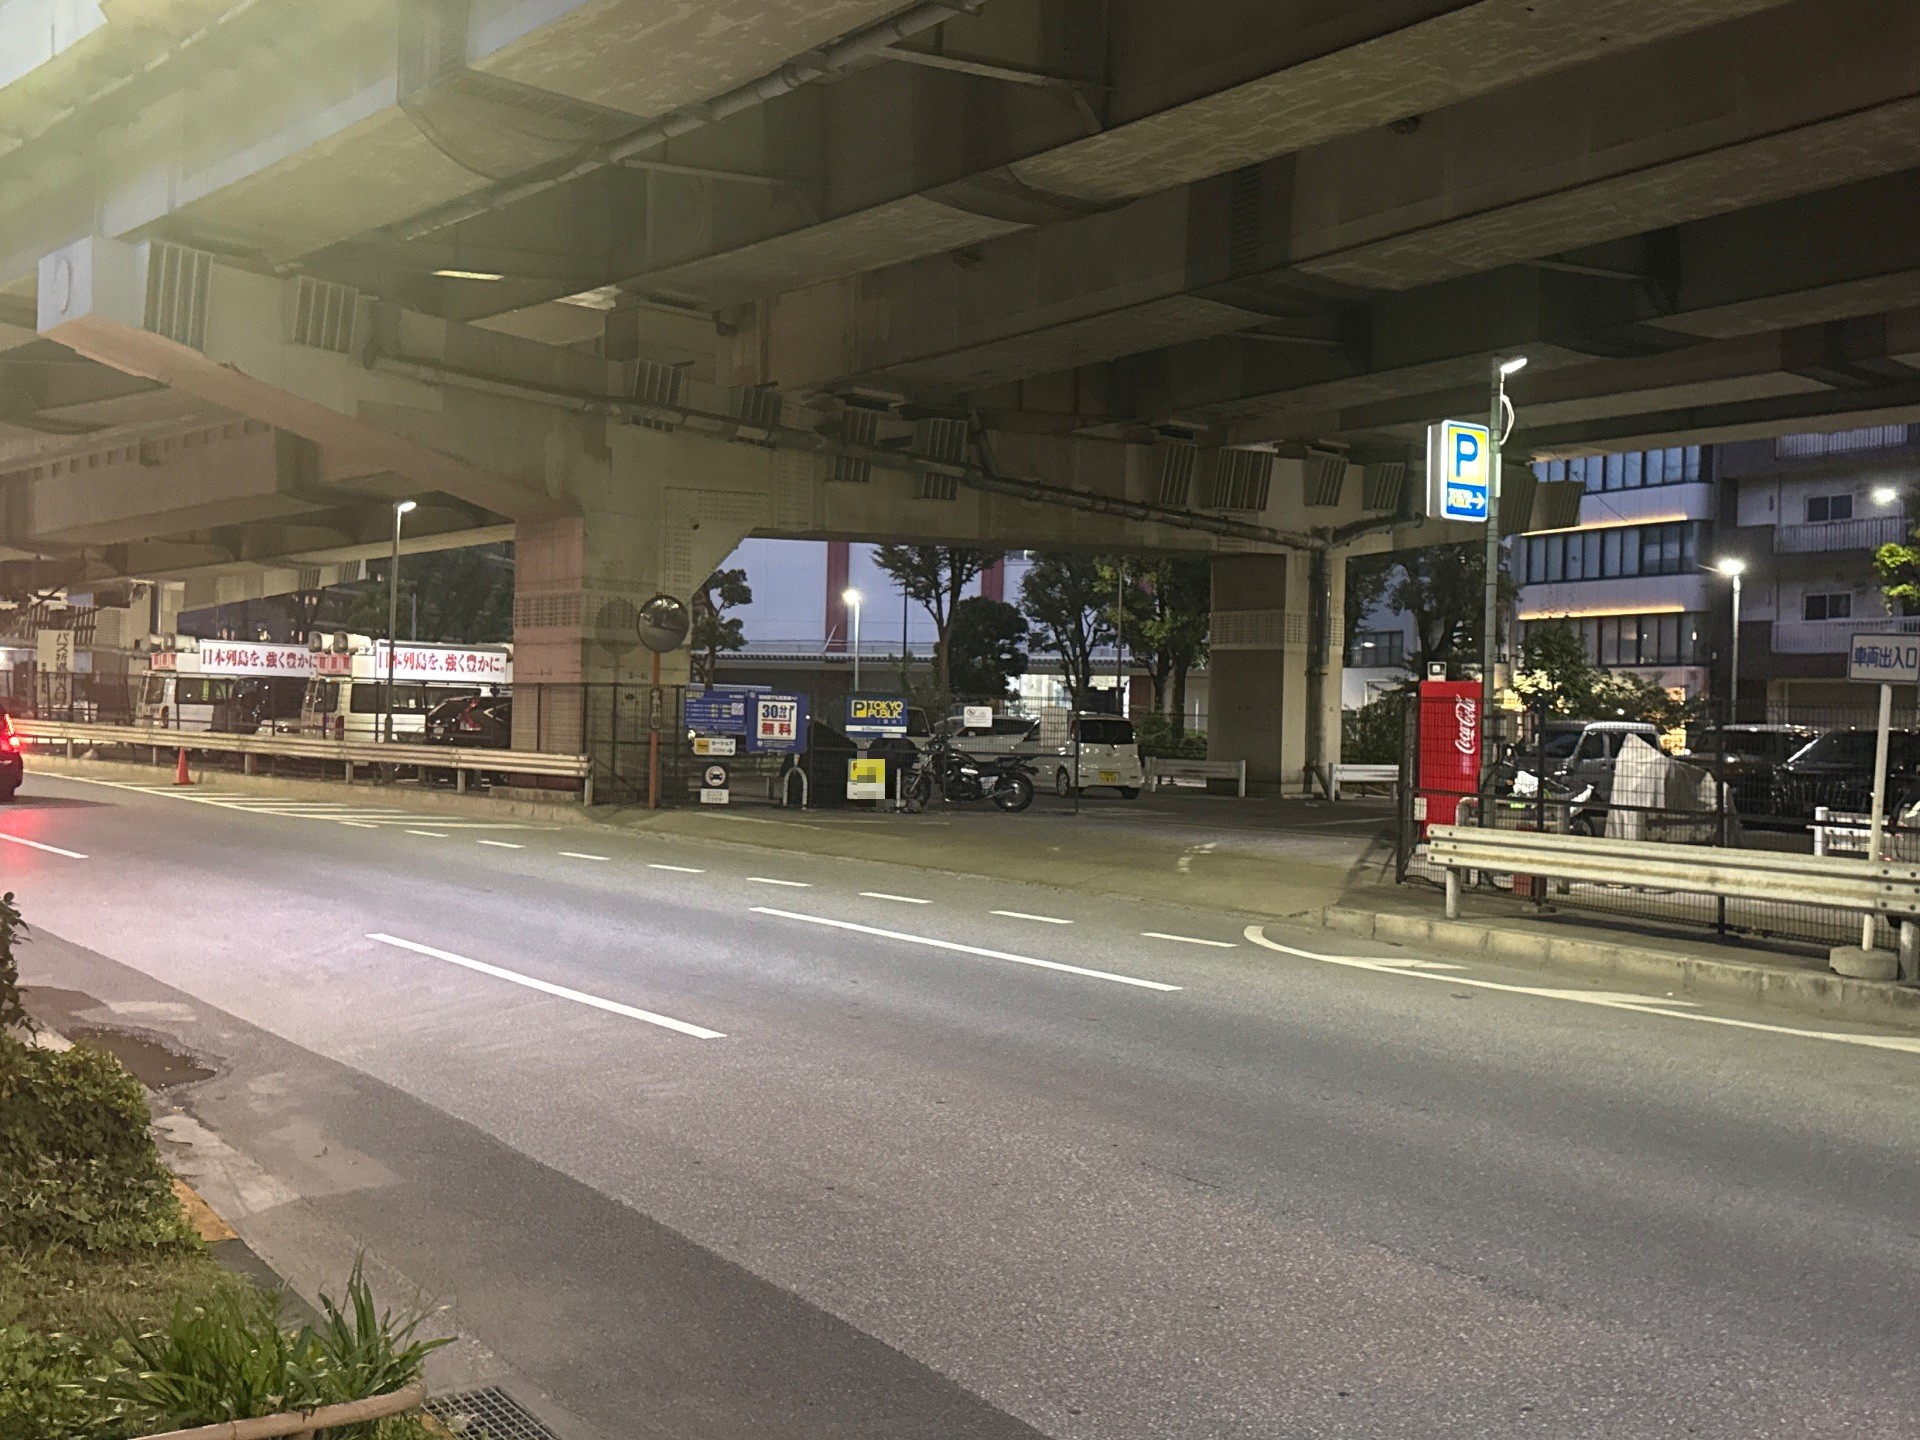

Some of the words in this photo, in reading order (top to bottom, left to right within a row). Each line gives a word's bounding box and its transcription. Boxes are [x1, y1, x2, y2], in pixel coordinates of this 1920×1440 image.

[1456, 432, 1479, 478] P
[1854, 645, 1917, 669] 車両出入口
[867, 700, 903, 710] TOKYO
[867, 709, 902, 718] PUBLIC
[762, 723, 791, 736] 無料
